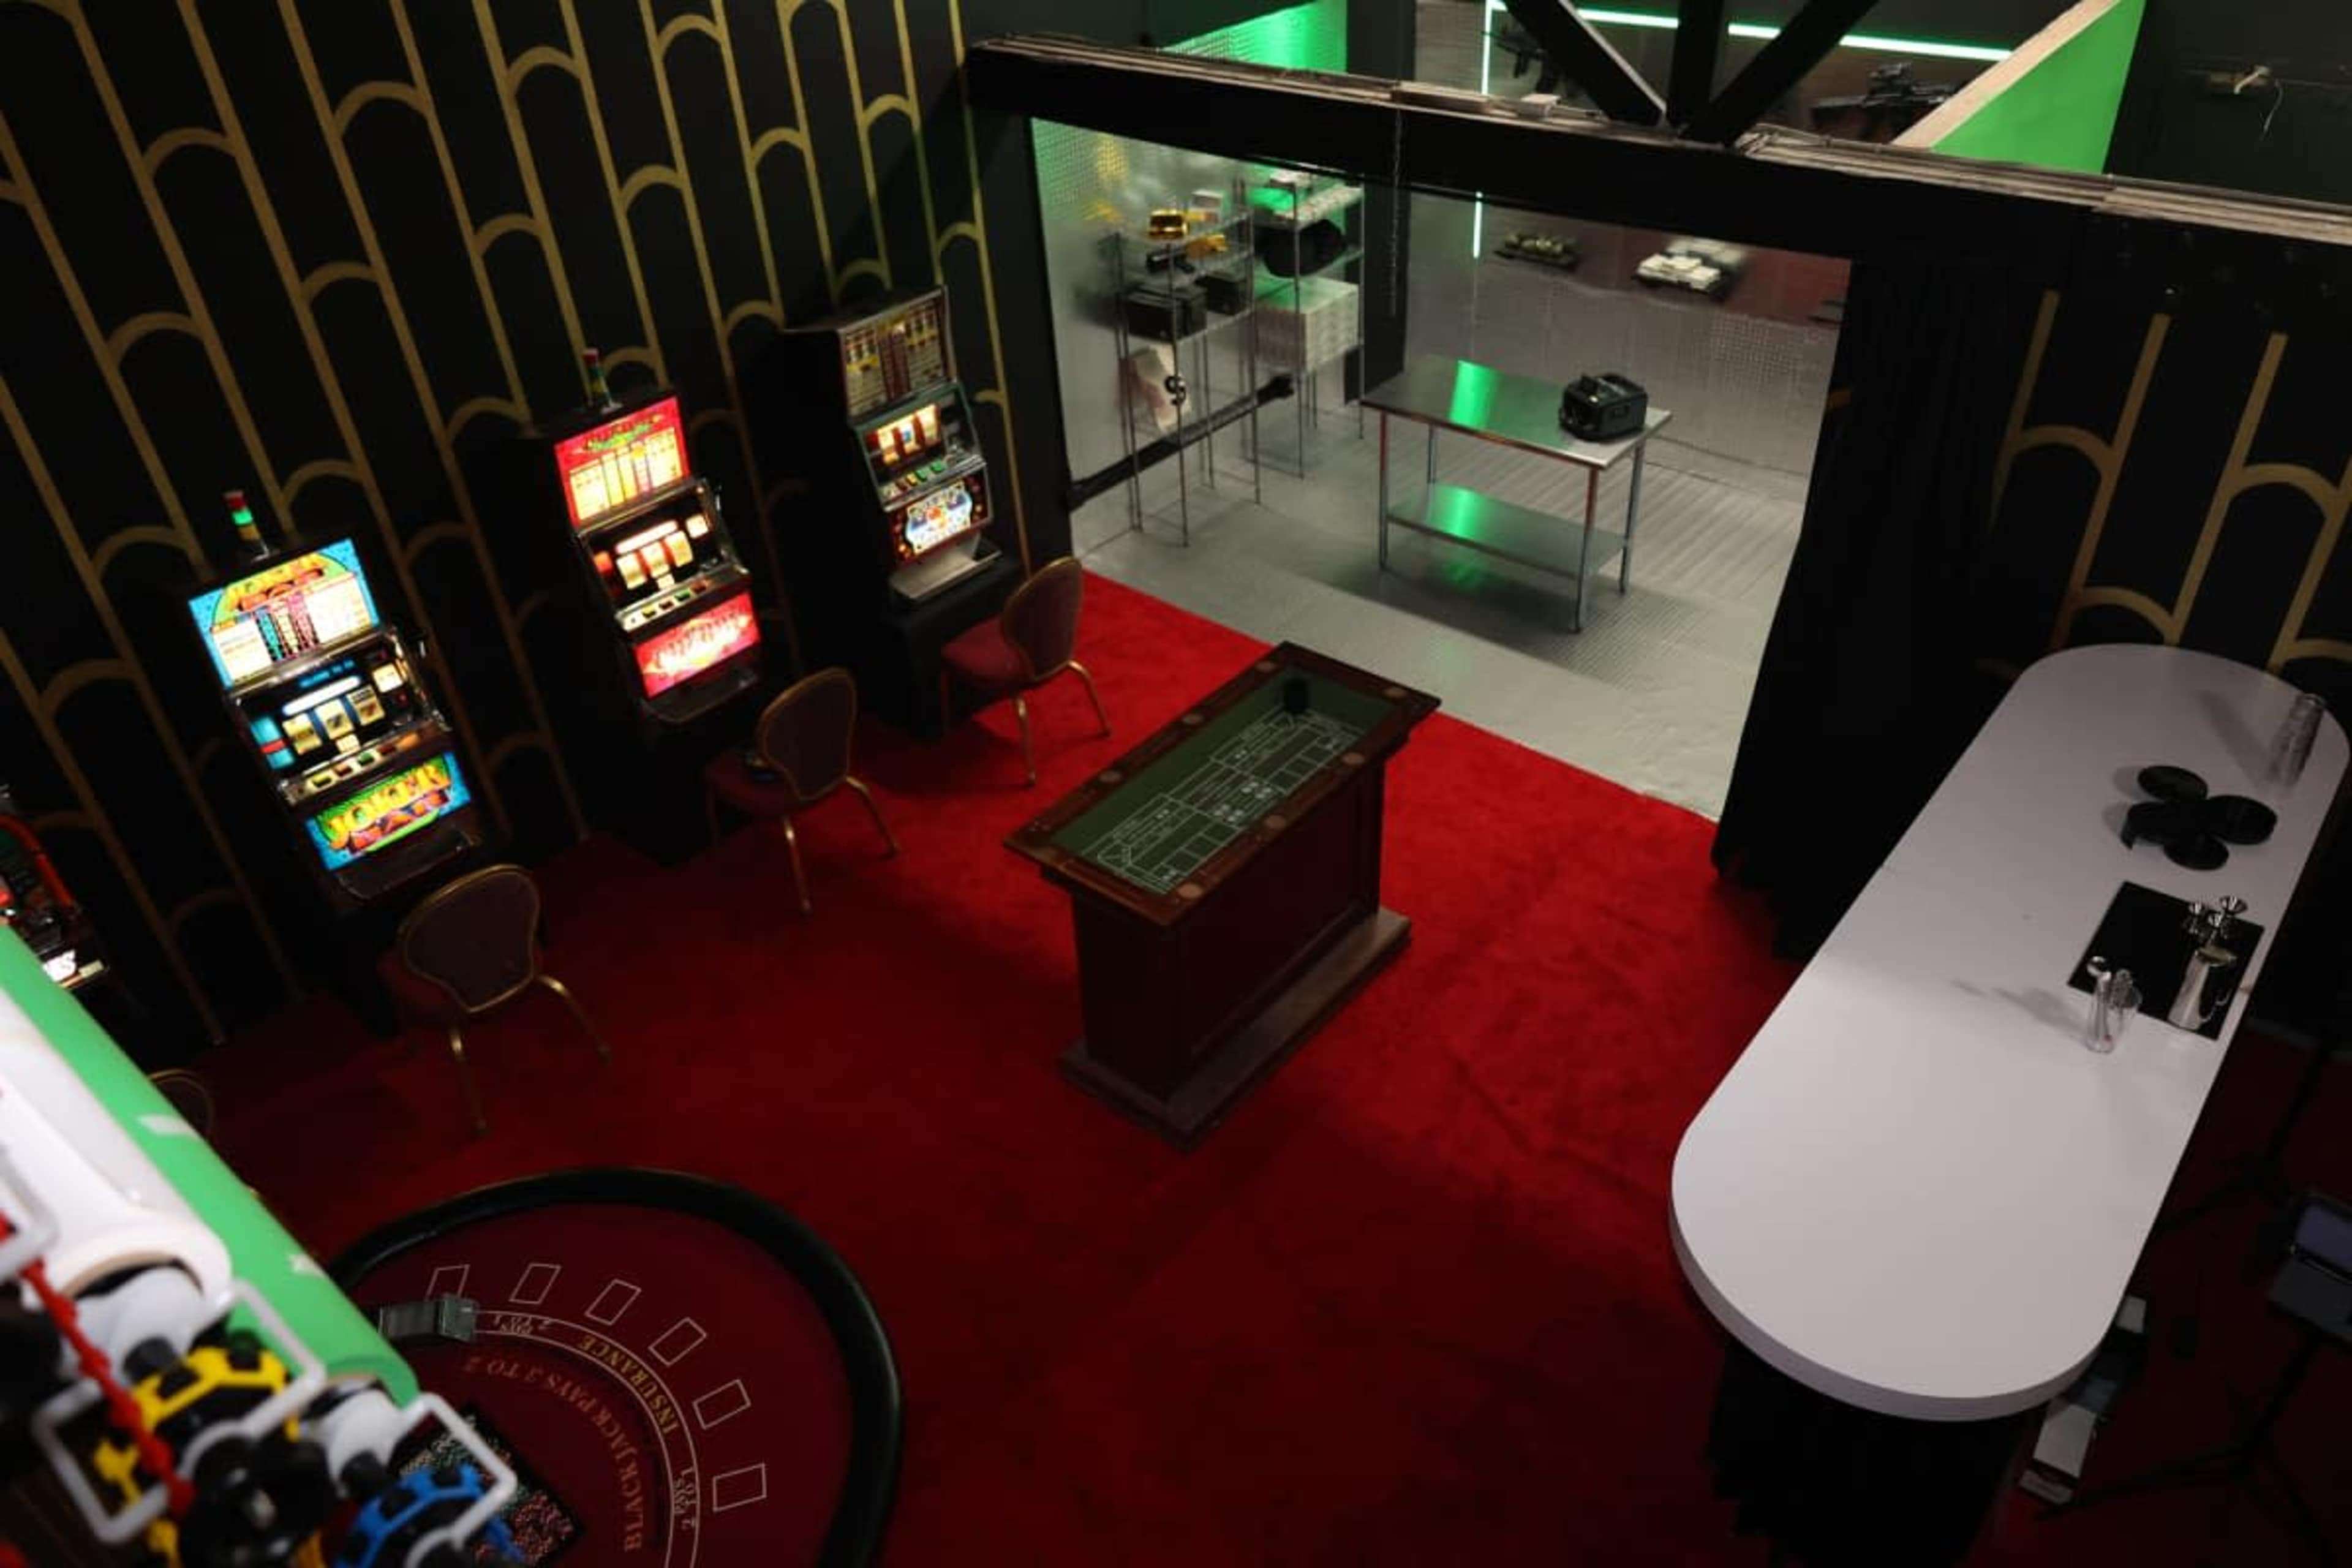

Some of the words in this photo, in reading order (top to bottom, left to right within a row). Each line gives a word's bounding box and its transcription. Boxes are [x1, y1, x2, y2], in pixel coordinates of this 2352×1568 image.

[331, 763, 452, 850] JOKER
[487, 1359, 519, 1378] TO
[524, 1363, 544, 1382] 3
[579, 1334, 679, 1434] INSURANCE
[546, 1373, 598, 1412] PAYS
